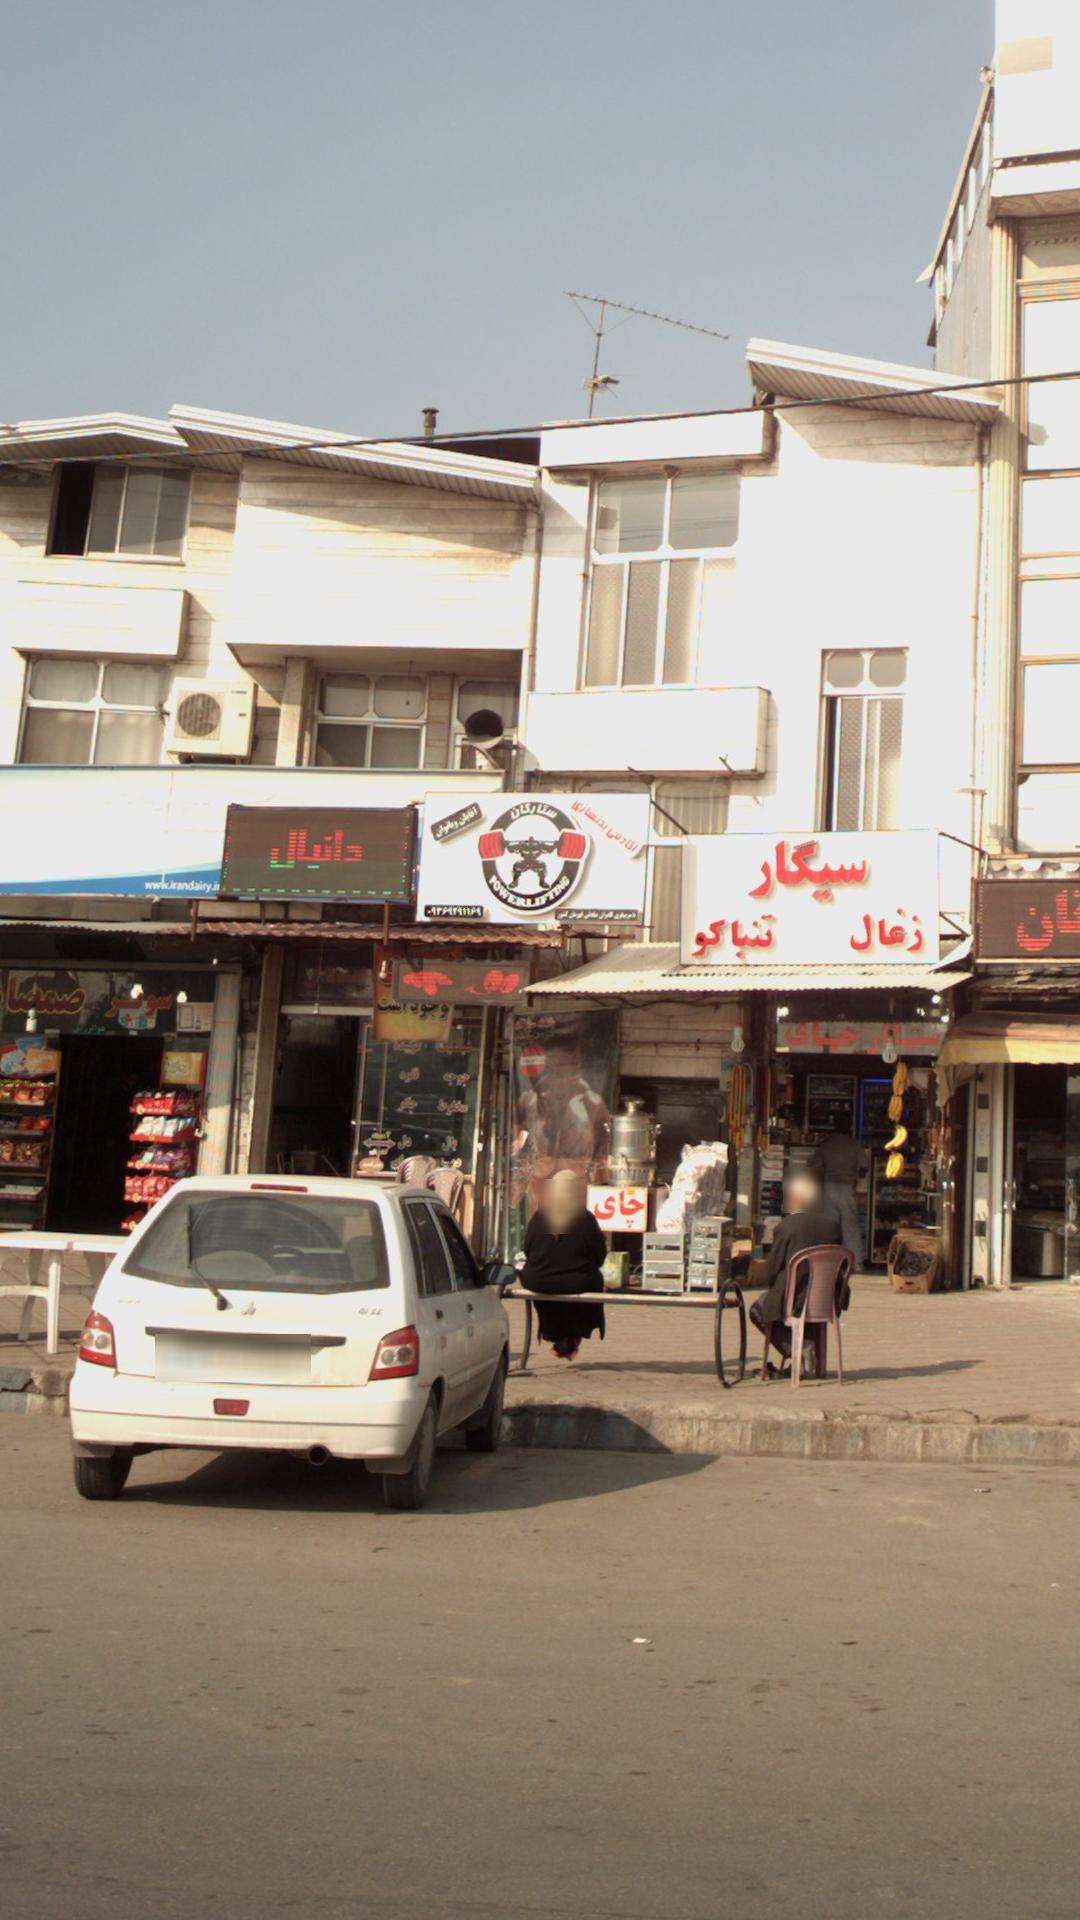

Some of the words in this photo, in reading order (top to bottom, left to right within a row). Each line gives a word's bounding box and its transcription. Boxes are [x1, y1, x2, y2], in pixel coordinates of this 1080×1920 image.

[270, 829, 363, 869] دانیال
[489, 875, 570, 907] POWERLIFTING
[748, 840, 868, 901] سیگار
[691, 912, 775, 957] تنباکو
[849, 908, 924, 952] زغال
[0, 974, 87, 1016] صمصا
[593, 1190, 645, 1228] چای
